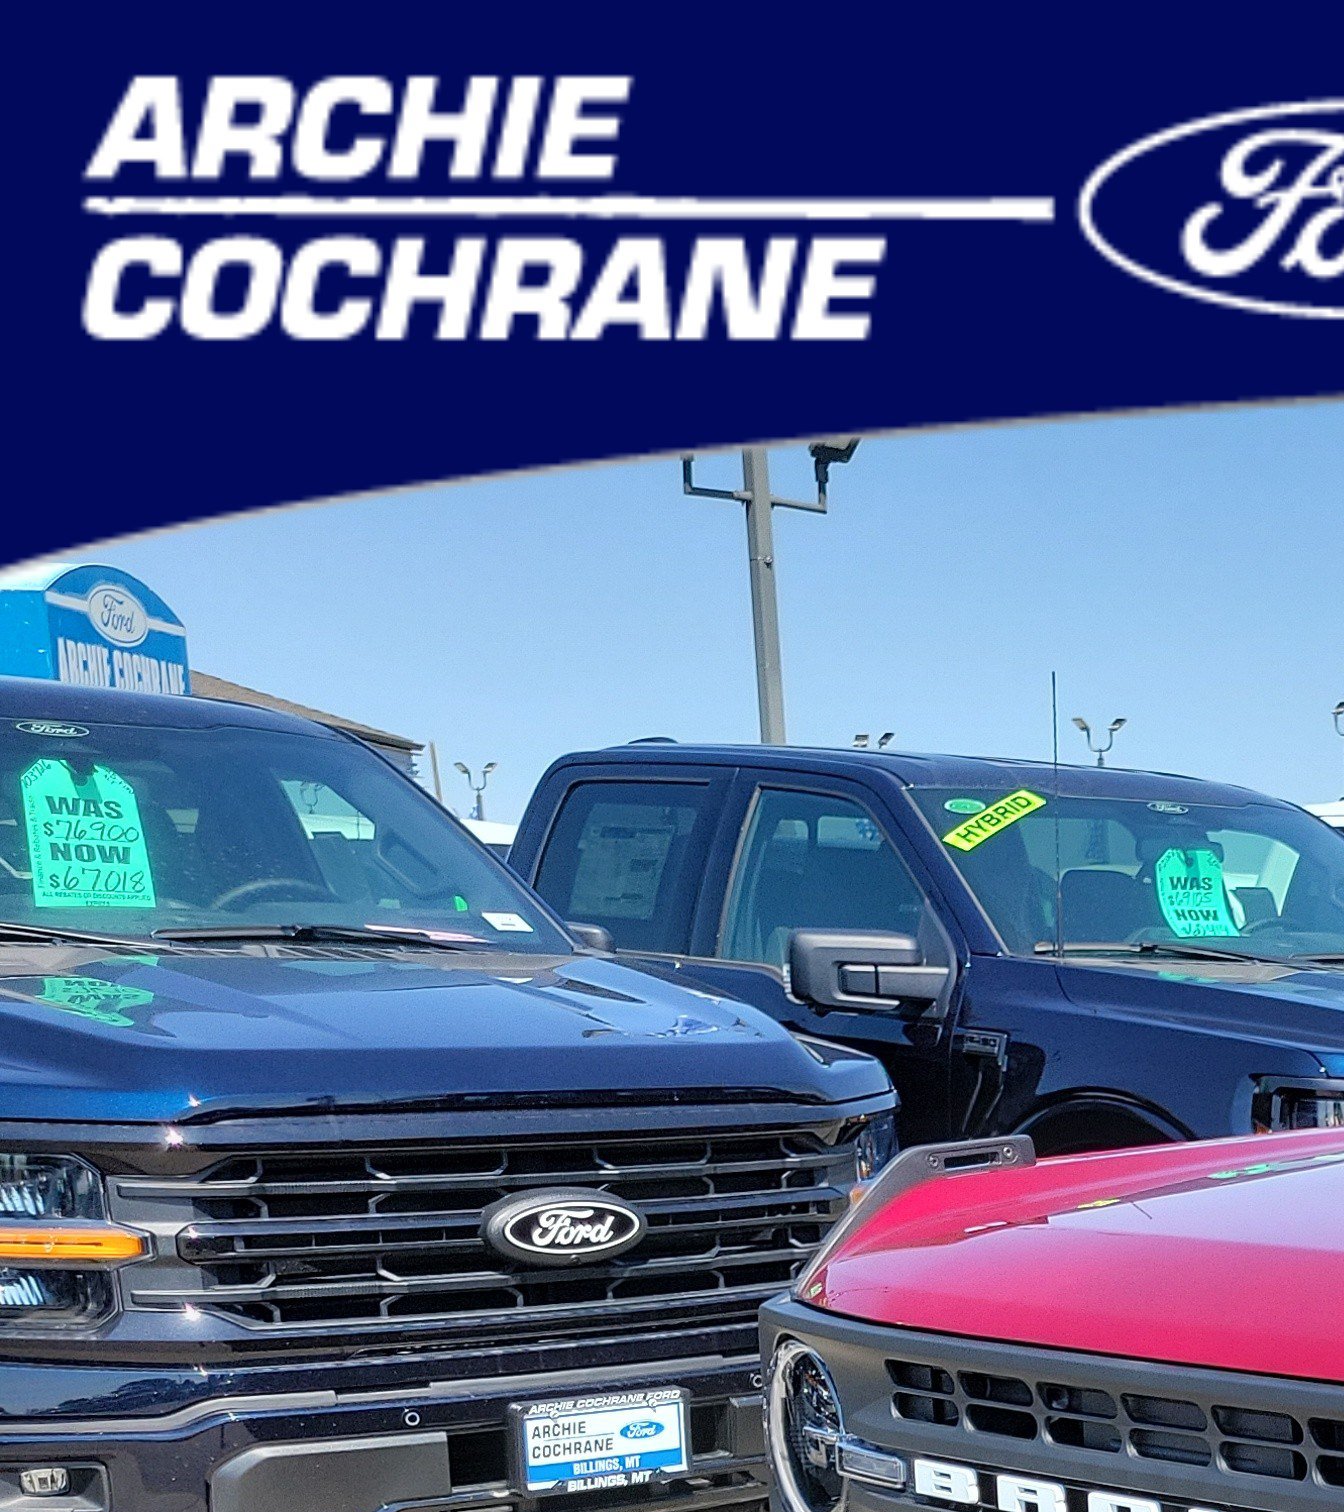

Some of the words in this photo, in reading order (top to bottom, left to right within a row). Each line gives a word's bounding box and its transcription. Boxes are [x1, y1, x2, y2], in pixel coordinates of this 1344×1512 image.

[101, 594, 136, 634] Ford
[58, 637, 110, 687] ARCHIE
[113, 649, 185, 696] COCHRANE
[45, 795, 123, 819] WAS
[43, 820, 140, 842] $76900
[955, 795, 1032, 844] HYBRID
[49, 842, 131, 865] NOW
[49, 866, 146, 893] $67018
[1169, 877, 1213, 891] WAS
[1174, 909, 1220, 922] NOW
[531, 1209, 615, 1246] Ford
[529, 1402, 573, 1416] ARCHIE
[576, 1394, 645, 1410] COCHRANE
[646, 1389, 681, 1401] FORD
[532, 1421, 587, 1440] ARCHIE
[532, 1438, 614, 1460] COCHRANE
[573, 1457, 624, 1476] BILLINGS,
[625, 1455, 642, 1469] MT
[567, 1473, 629, 1493] BILLINGS,
[631, 1471, 653, 1484] MT
